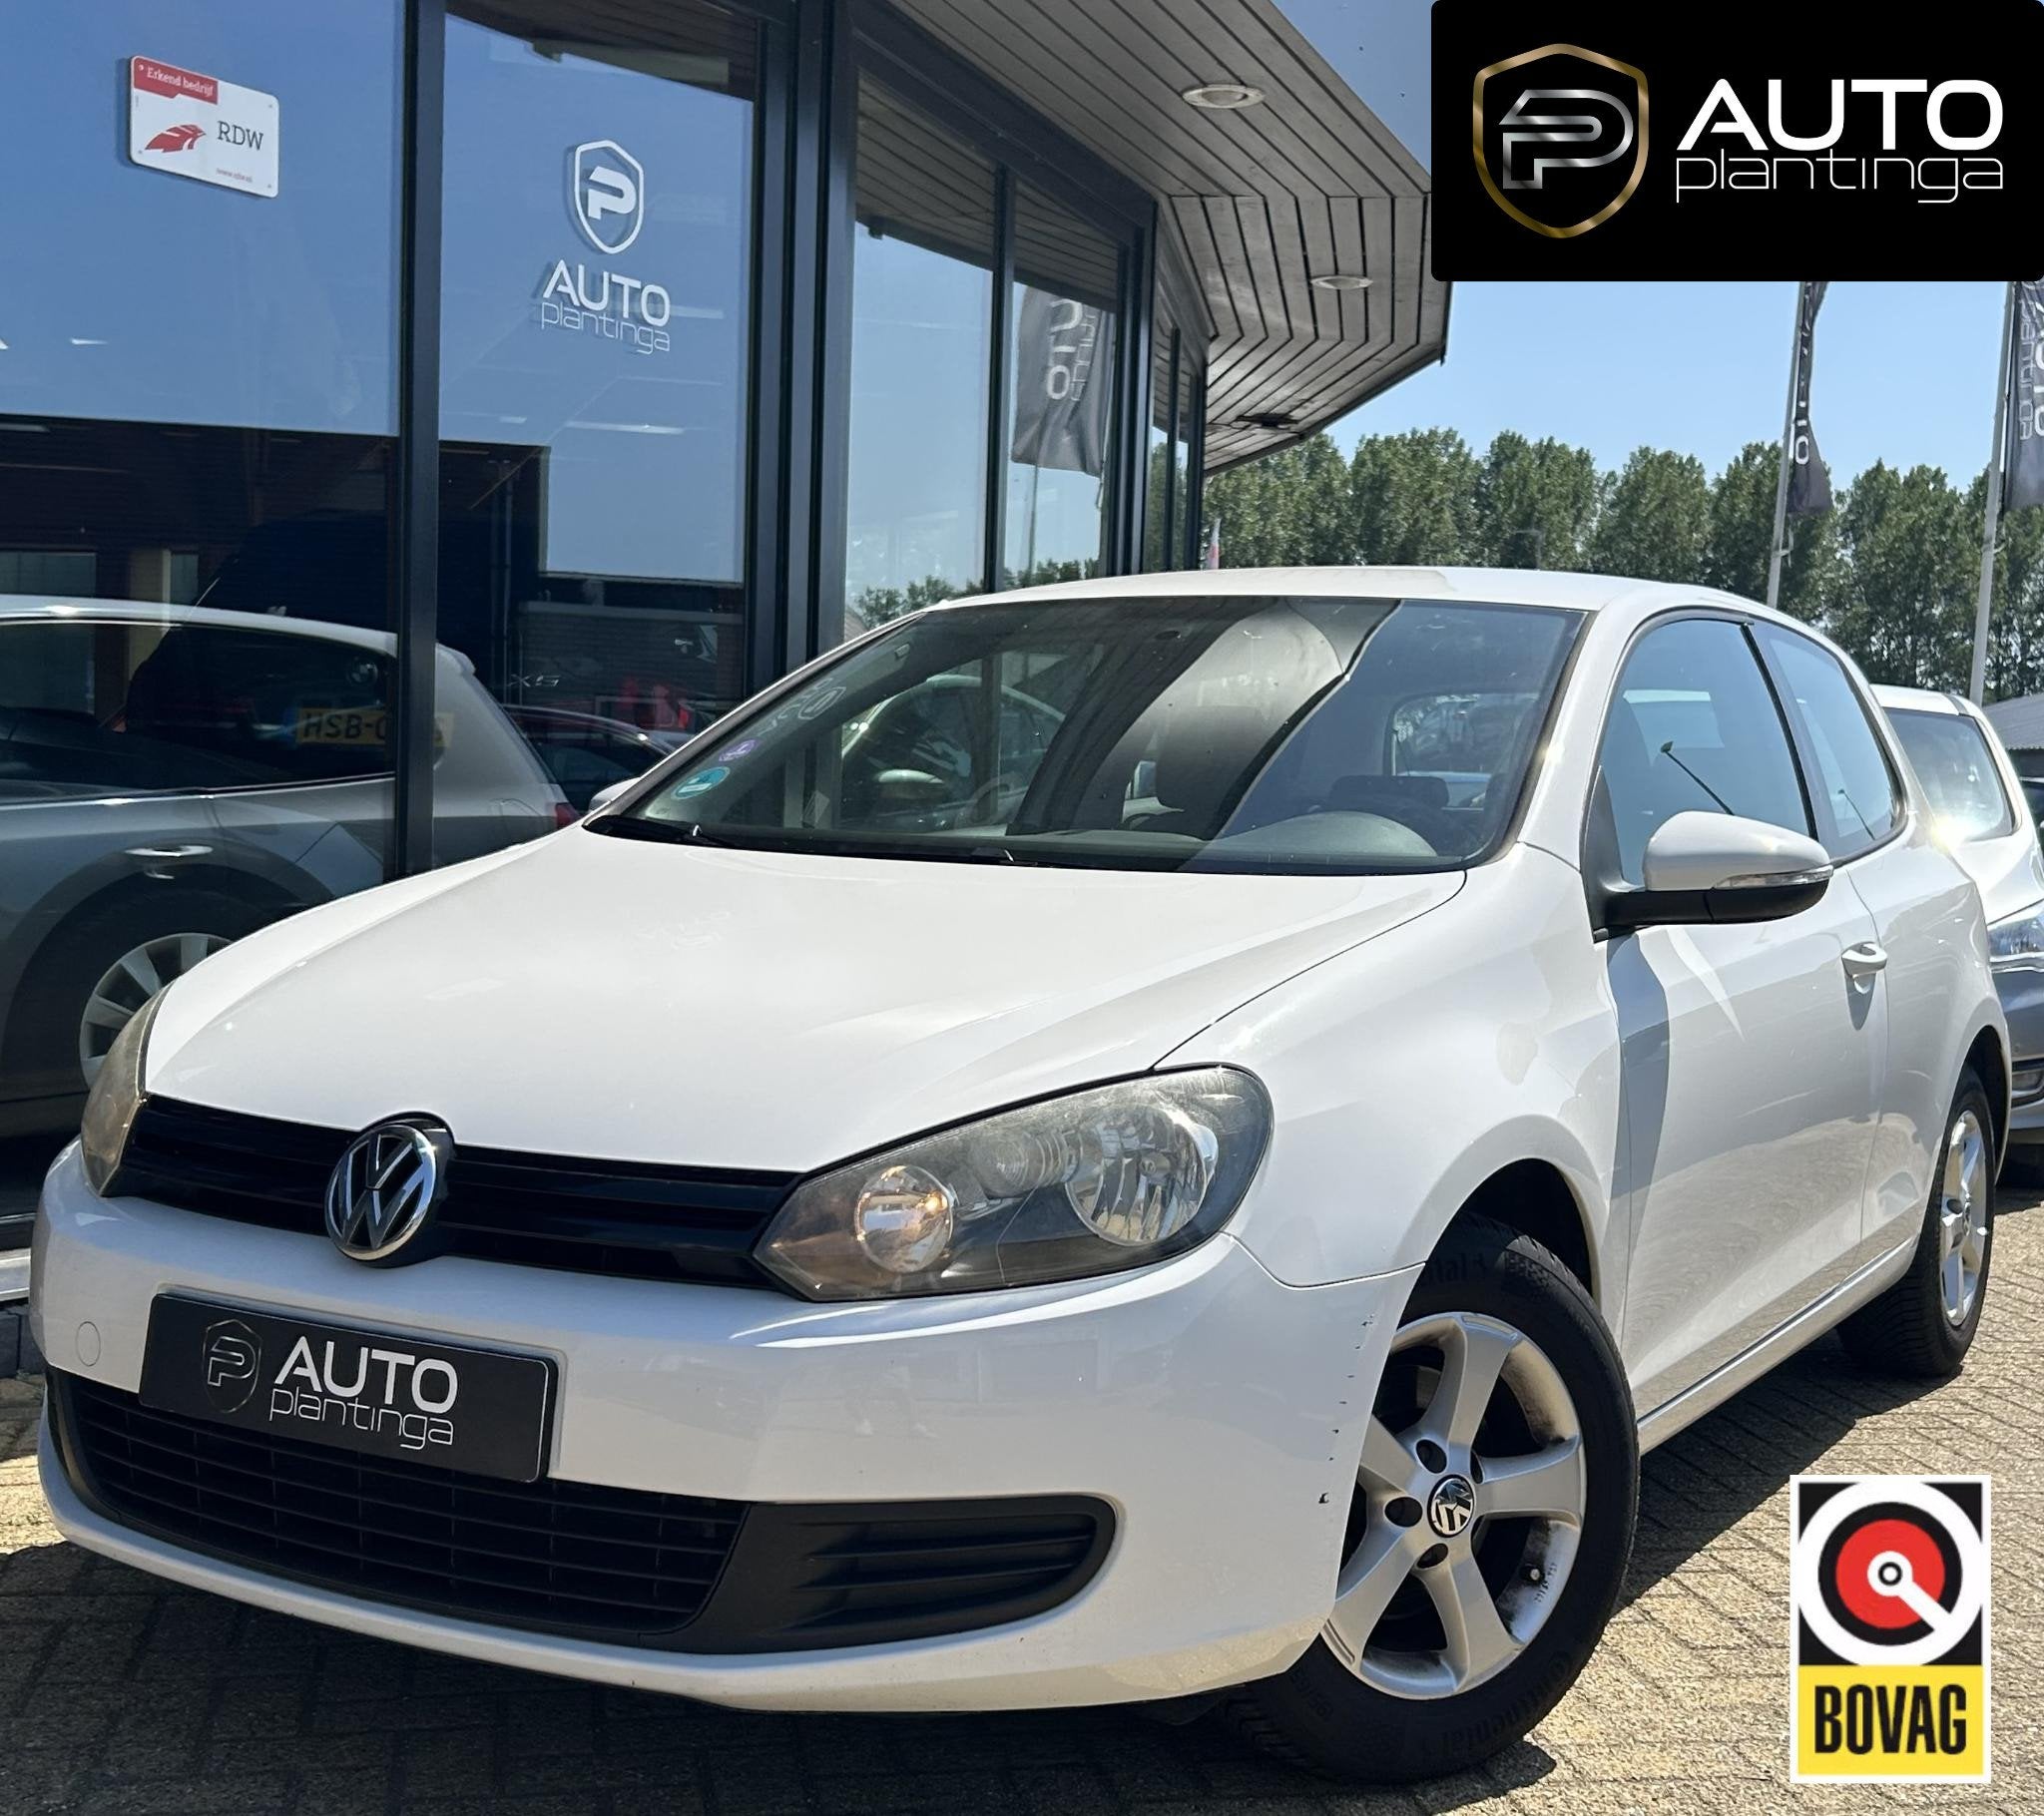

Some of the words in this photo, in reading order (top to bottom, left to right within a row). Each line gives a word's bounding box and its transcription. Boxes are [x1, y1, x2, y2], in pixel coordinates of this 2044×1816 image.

[147, 67, 182, 87] Erkend
[183, 77, 214, 97] bedrijf
[218, 121, 263, 151] RDW
[543, 259, 671, 327] AUTO
[541, 301, 671, 354] plantinga
[274, 1335, 458, 1414] AUTO
[269, 1386, 454, 1450] plantinga
